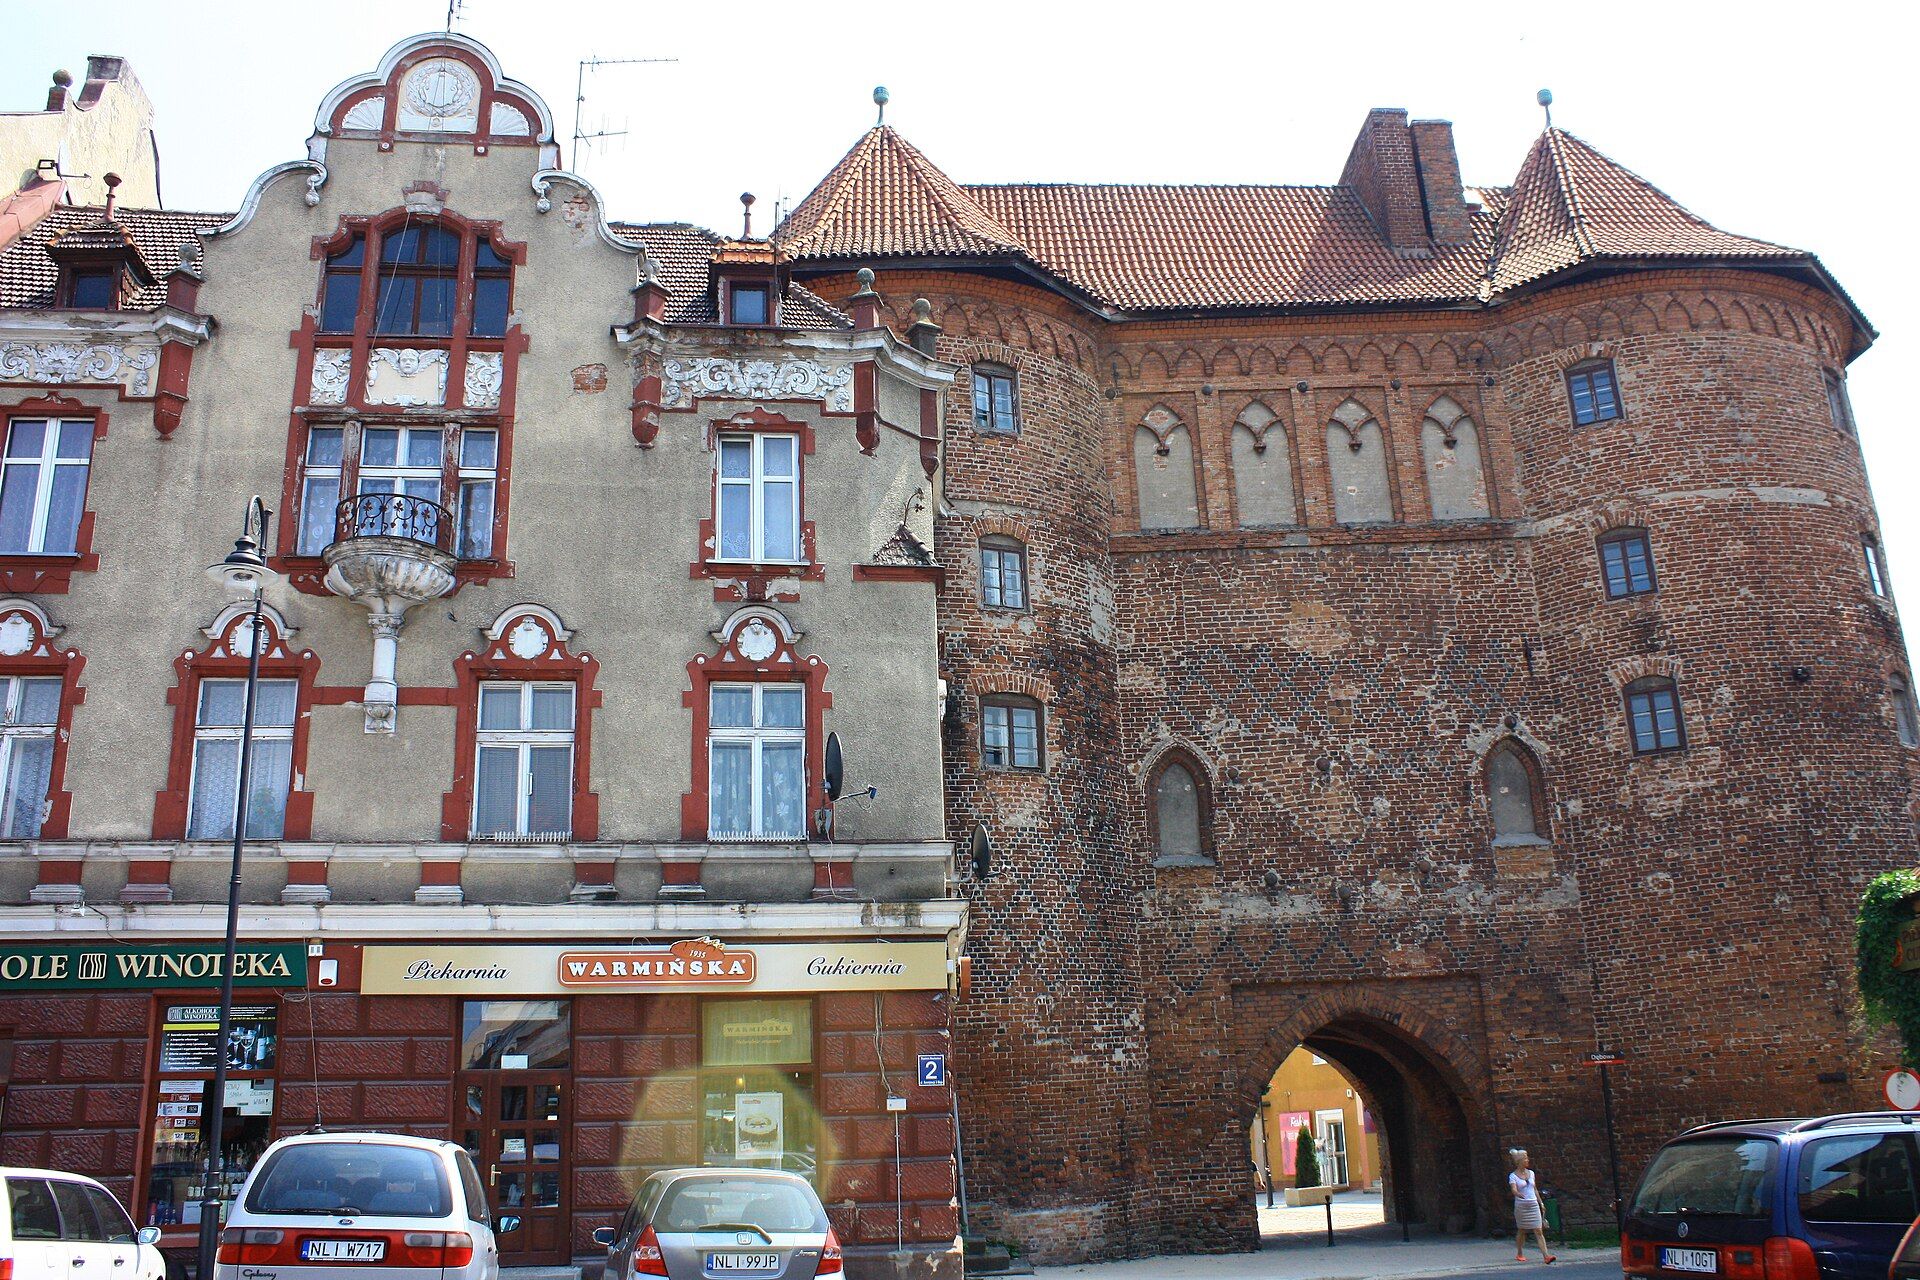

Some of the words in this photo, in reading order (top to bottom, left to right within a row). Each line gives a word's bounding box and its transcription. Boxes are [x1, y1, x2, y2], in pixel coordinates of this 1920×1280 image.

[689, 950, 706, 959] 1935
[0, 955, 69, 980] OLE
[115, 952, 292, 979] WINOTEKA
[403, 959, 511, 980] Piekarnia
[567, 957, 746, 977] WARMIŃSKA
[806, 956, 906, 977] Cukiernia
[925, 1060, 938, 1080] 2
[310, 1242, 339, 1256] NLI
[346, 1243, 382, 1258] W717
[1666, 1249, 1685, 1266] NLI
[1690, 1251, 1714, 1268] 10GT
[715, 1255, 739, 1268] NLI
[746, 1255, 777, 1268] 99JP
